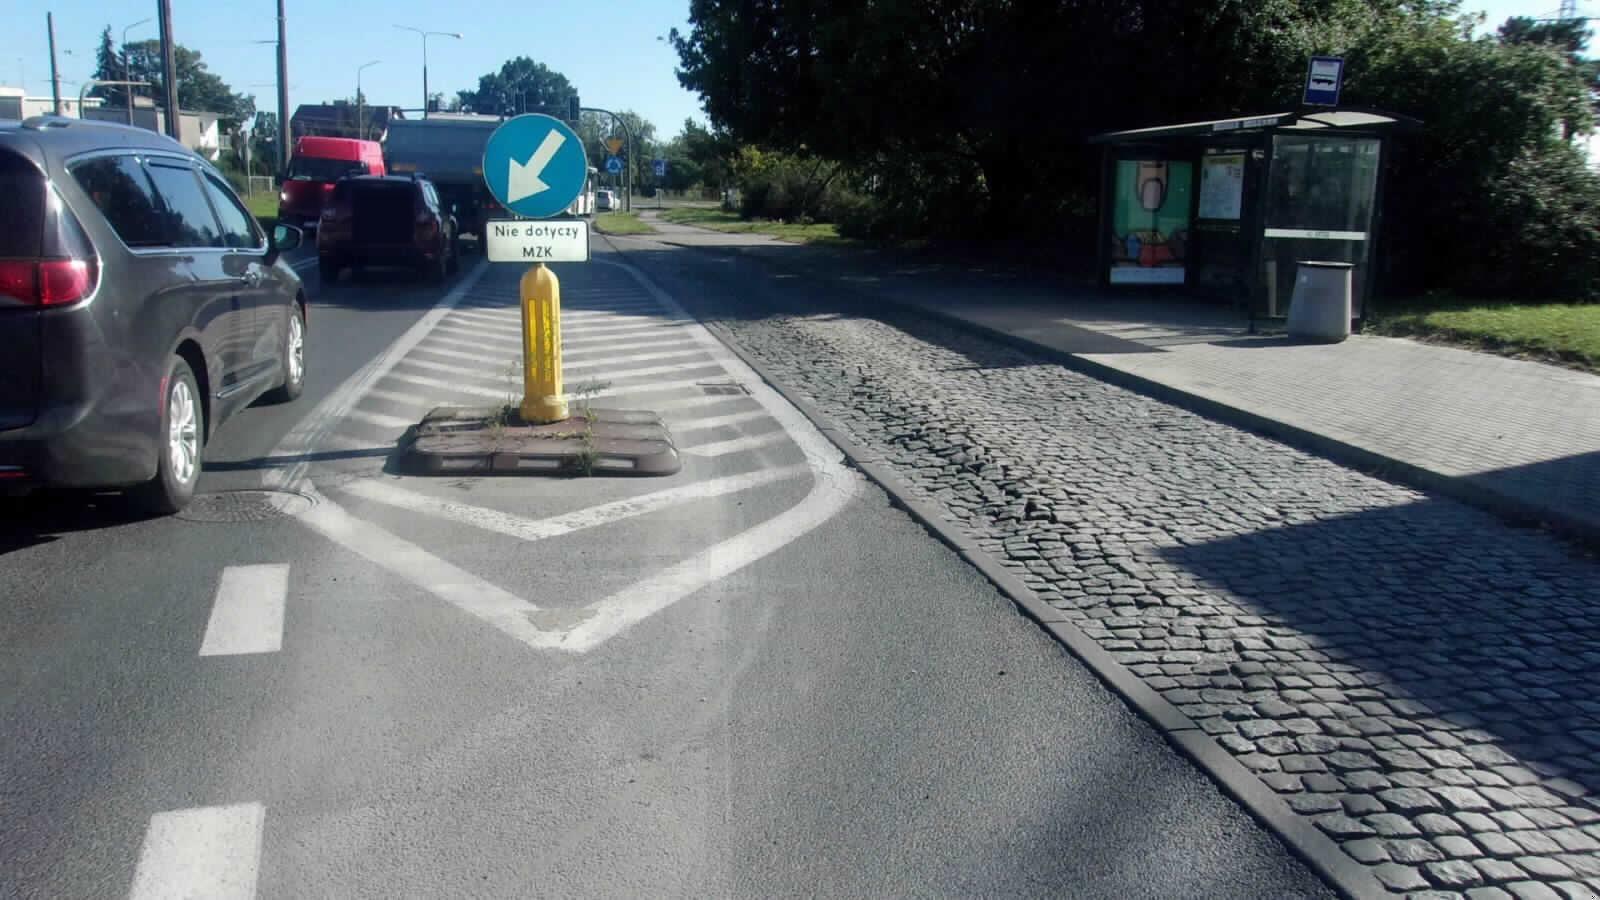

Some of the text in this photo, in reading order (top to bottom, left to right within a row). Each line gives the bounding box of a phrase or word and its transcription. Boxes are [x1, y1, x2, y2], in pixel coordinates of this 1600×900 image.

[495, 224, 579, 239] Nie dotyczy
[522, 246, 553, 257] MZK
